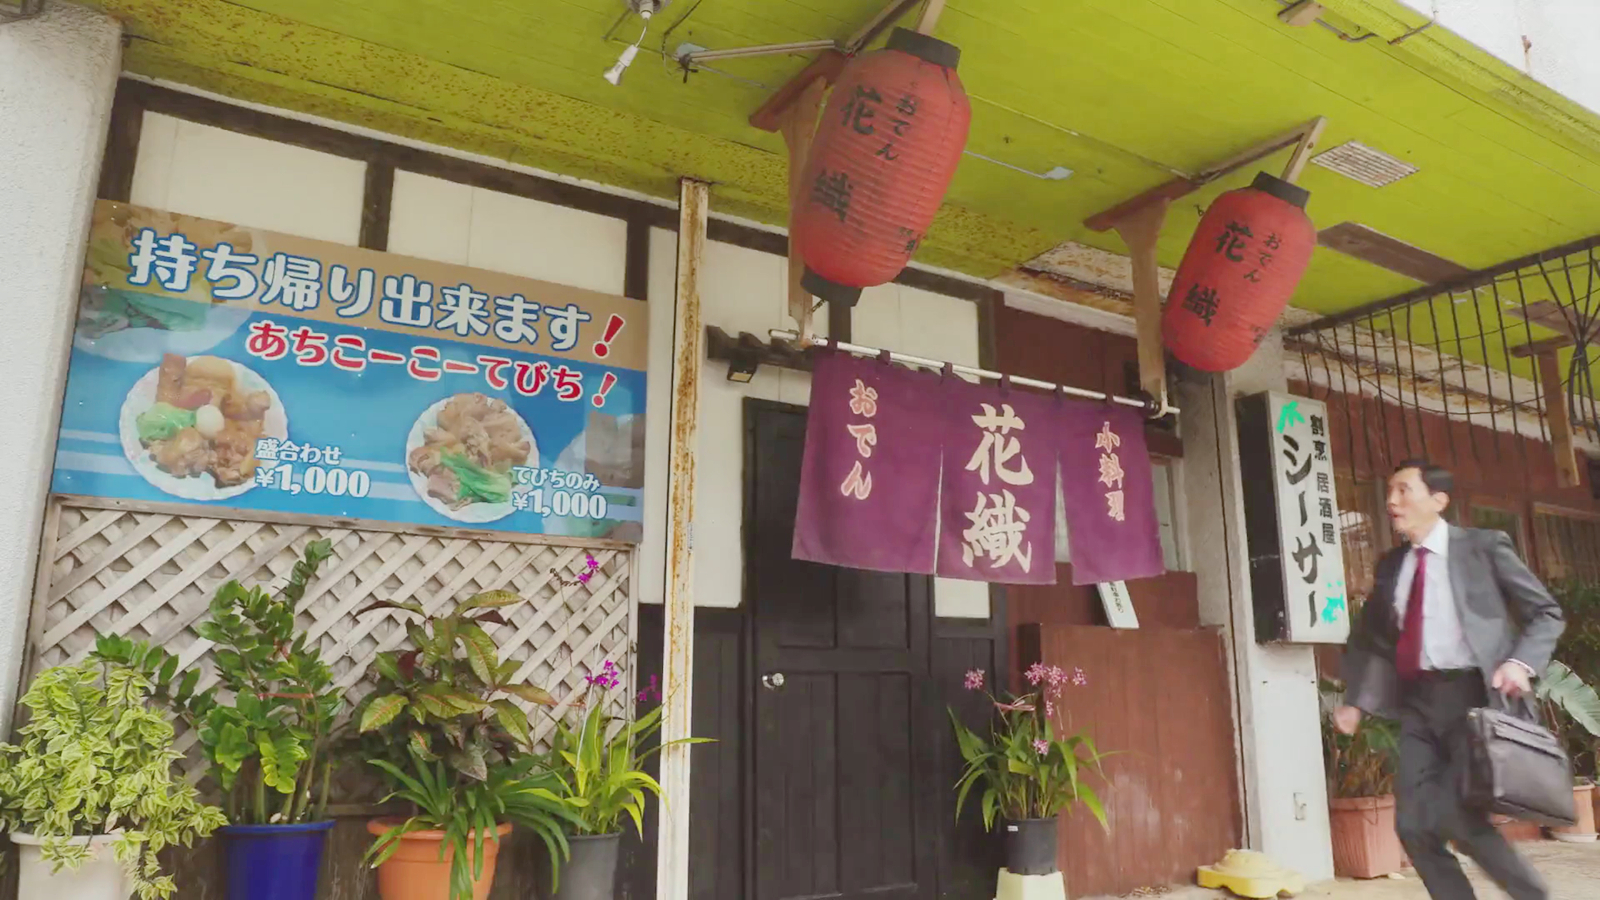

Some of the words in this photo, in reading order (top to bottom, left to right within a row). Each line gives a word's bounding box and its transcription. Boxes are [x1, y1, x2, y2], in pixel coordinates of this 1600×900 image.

[128, 228, 626, 358] 持ち帰り出来ます！
[245, 321, 617, 407] あちこーこーてびち！
[255, 438, 342, 466] 盛合わせ
[512, 466, 600, 492] てびちのみ
[840, 379, 880, 501] おでん
[255, 463, 370, 498] ¥1,000
[512, 488, 607, 519] ¥1,000
[961, 402, 1035, 574] 花織
[1316, 471, 1336, 545] 居酒屋
[1282, 434, 1324, 628] シーサー
